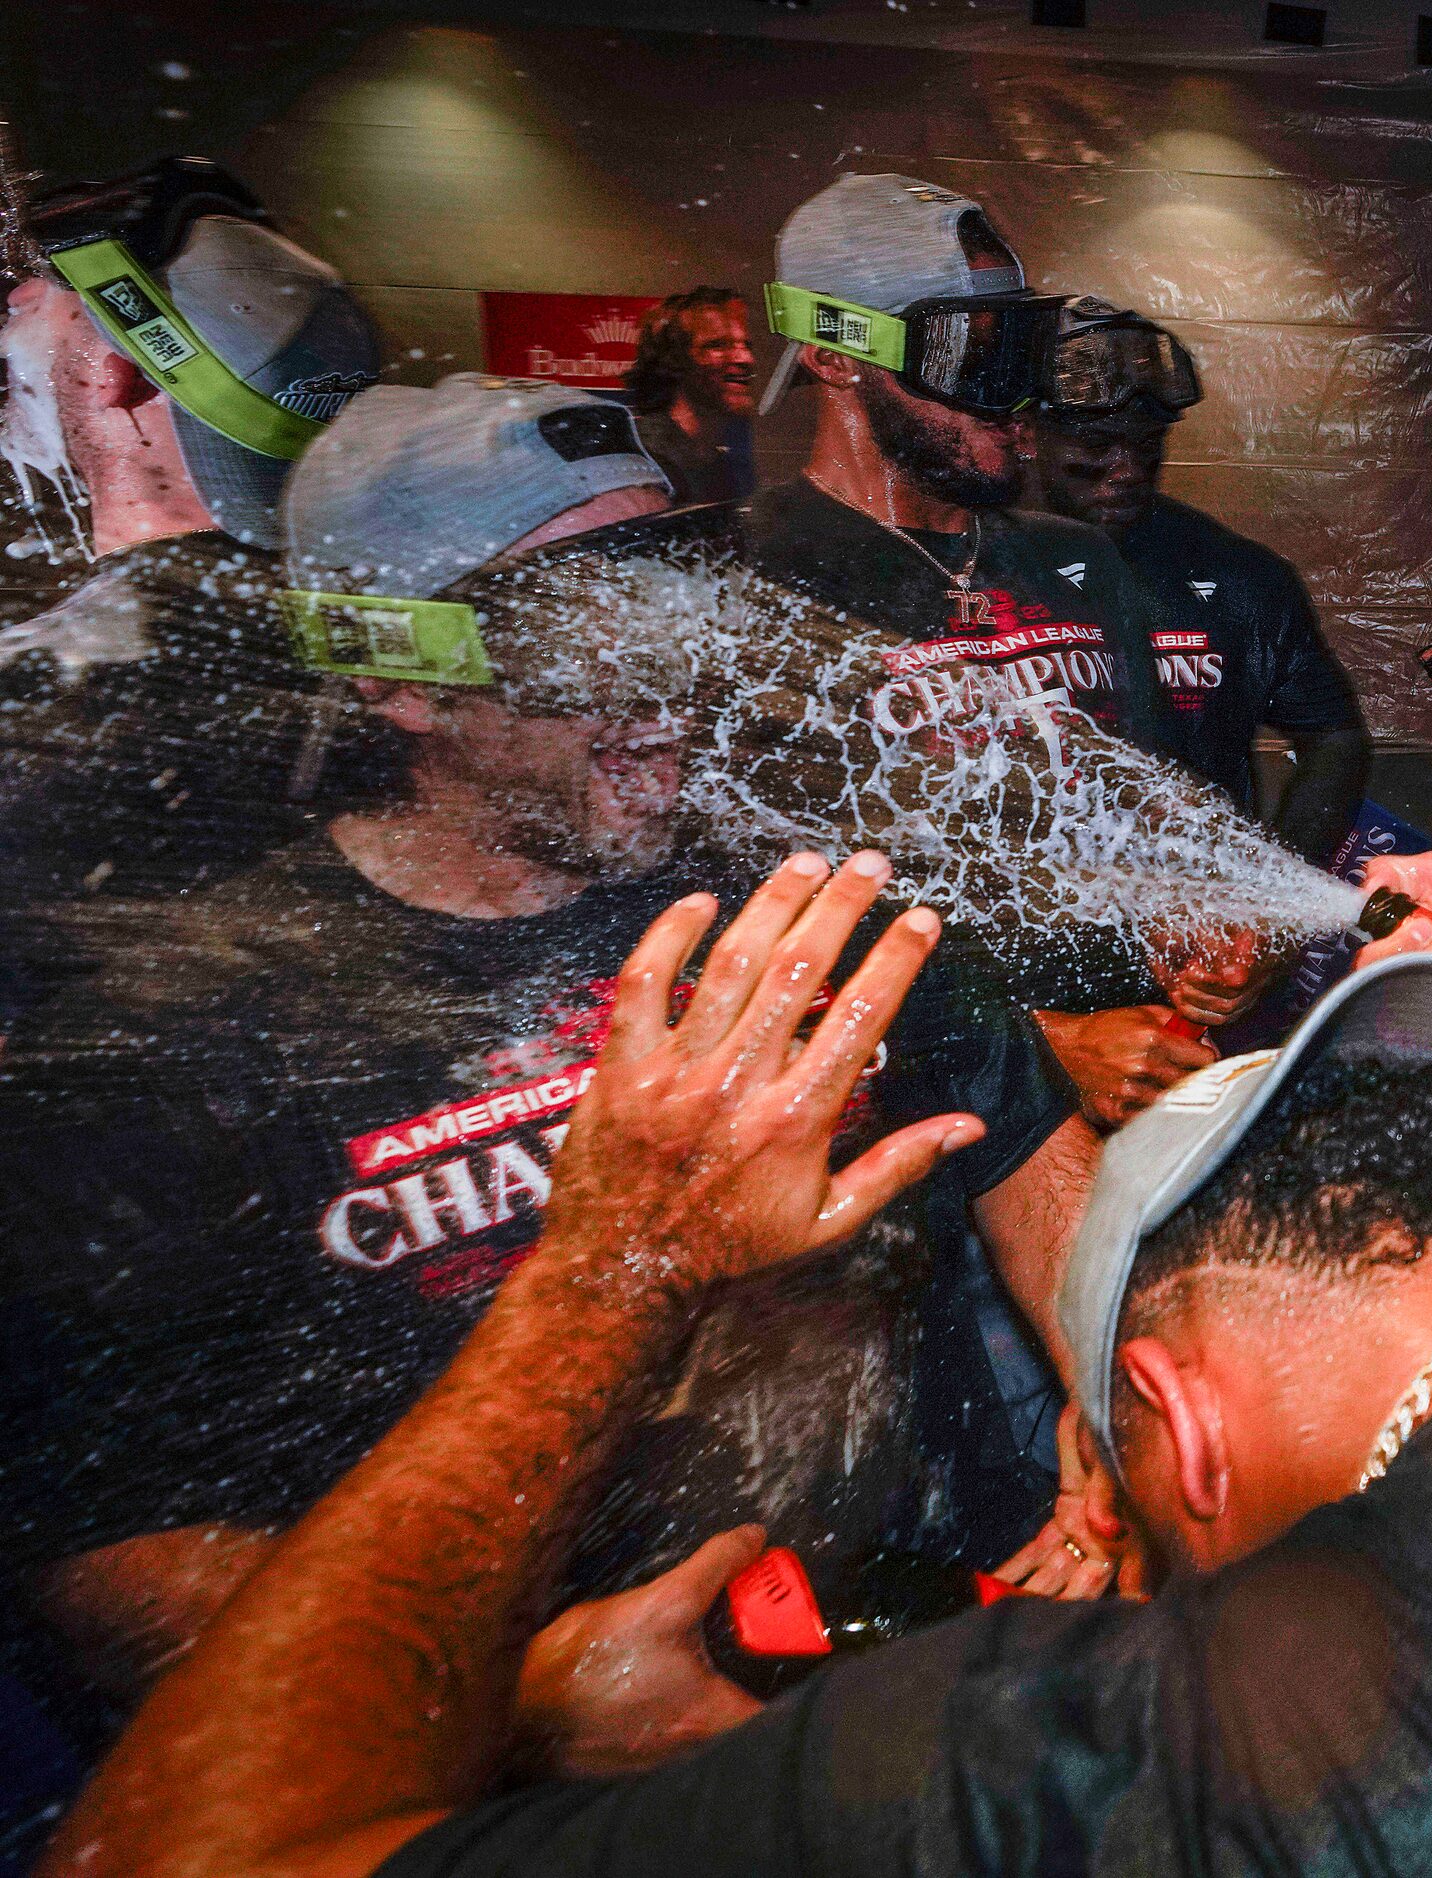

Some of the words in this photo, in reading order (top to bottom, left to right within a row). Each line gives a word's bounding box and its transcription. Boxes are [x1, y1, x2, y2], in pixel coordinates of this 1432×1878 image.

[138, 330, 174, 363] ERA
[150, 324, 185, 357] NEW
[898, 632, 1029, 669] AMERICAN
[1031, 623, 1104, 646] LEAGUE
